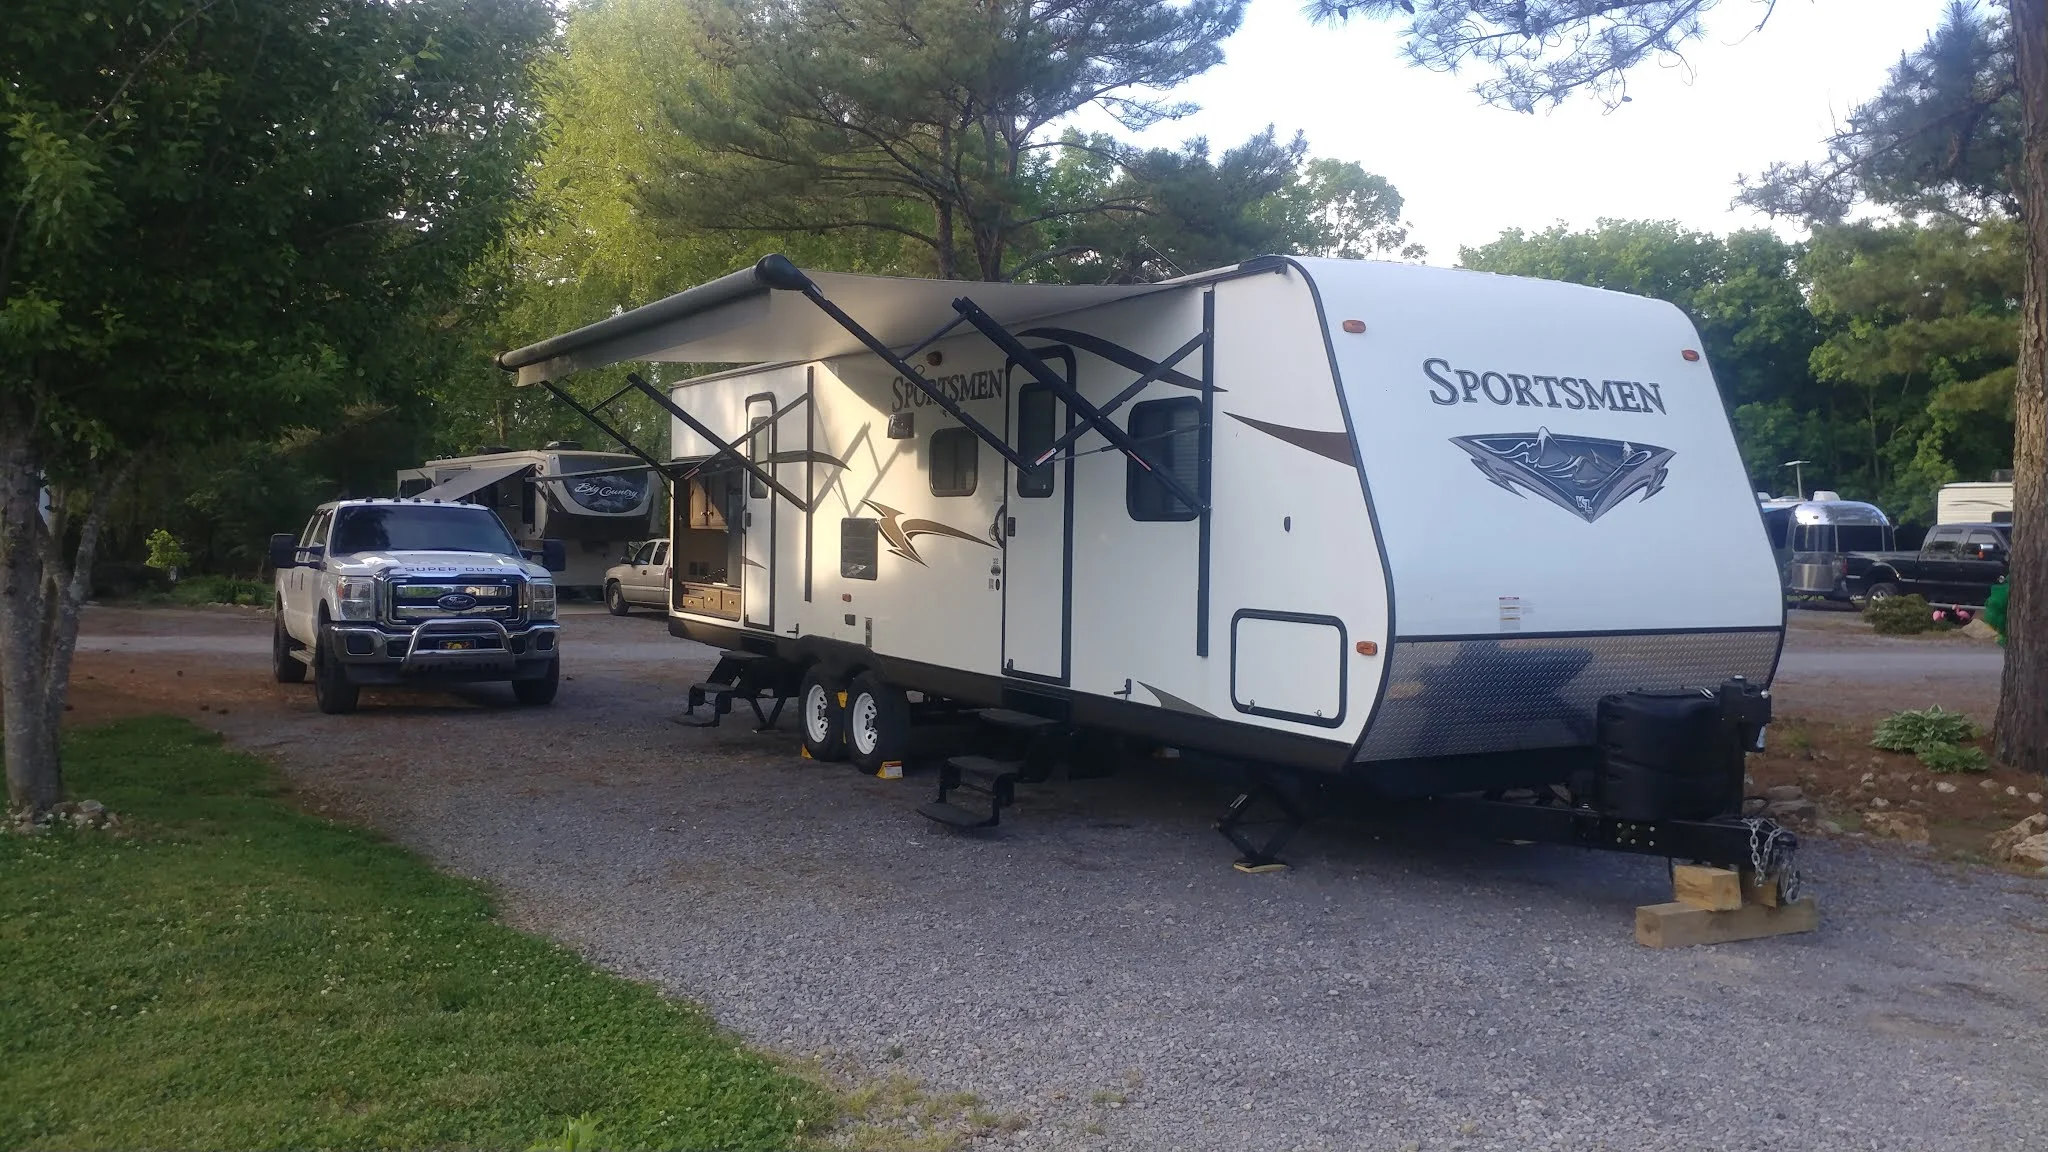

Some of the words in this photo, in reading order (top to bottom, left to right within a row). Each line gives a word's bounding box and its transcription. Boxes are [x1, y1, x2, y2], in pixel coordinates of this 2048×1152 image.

[1422, 358, 1667, 415] SPORTSMEN
[574, 483, 600, 496] Big
[600, 487, 639, 500] Country
[448, 596, 468, 604] Ford
